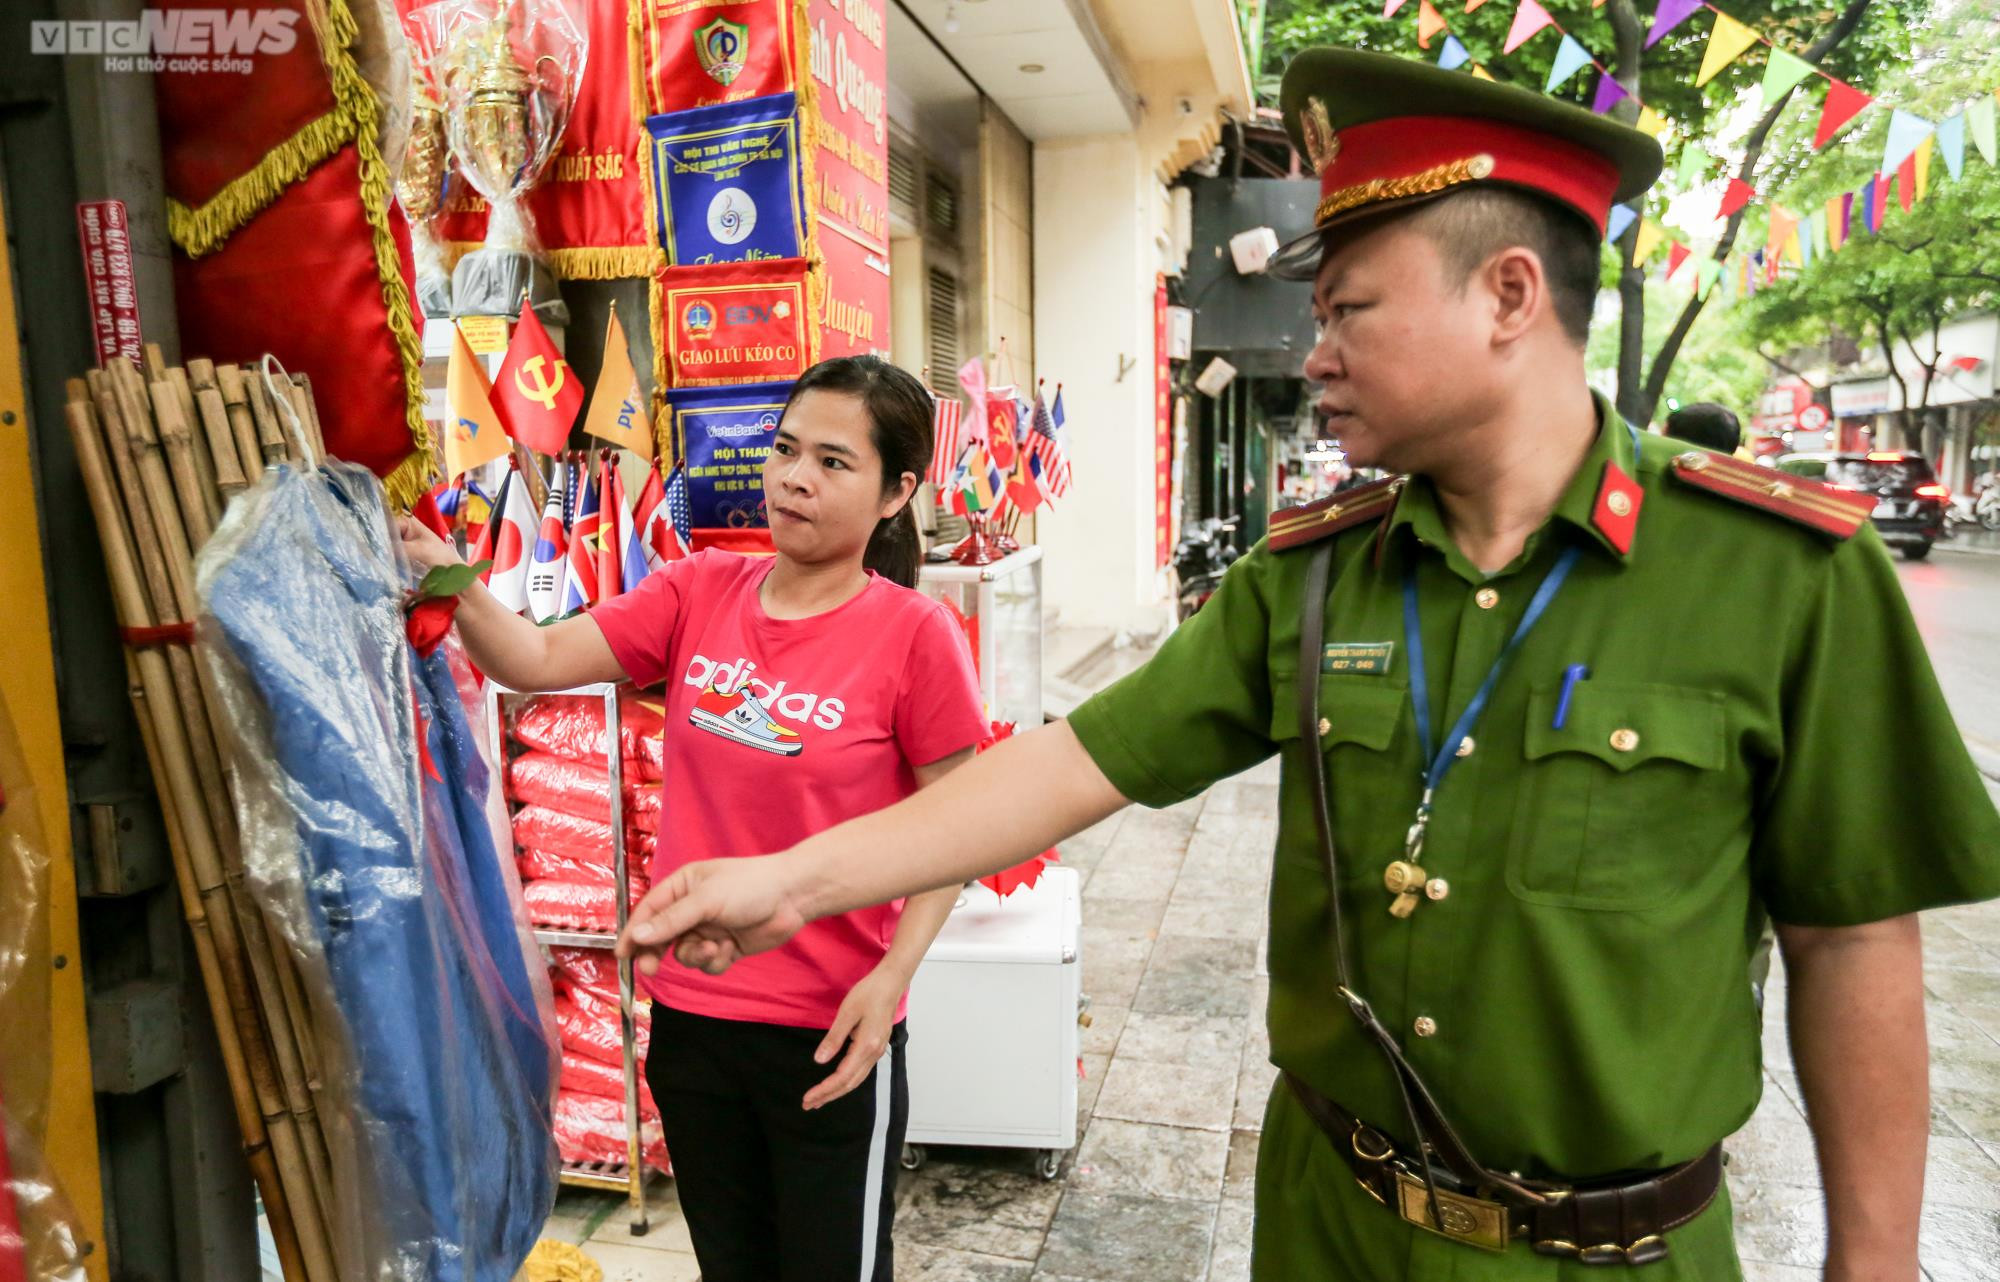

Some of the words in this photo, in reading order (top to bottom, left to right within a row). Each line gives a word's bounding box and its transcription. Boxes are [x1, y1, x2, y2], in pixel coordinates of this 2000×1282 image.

[836, 32, 883, 145] Quang
[595, 145, 624, 180] SẮC
[725, 304, 774, 325] BIDV
[679, 350, 713, 366] GIAO
[745, 342, 774, 363] KÉO
[775, 346, 796, 361] CO
[706, 423, 764, 438] VietinBank
[713, 447, 735, 461] HỘI
[684, 654, 846, 731] adidas
